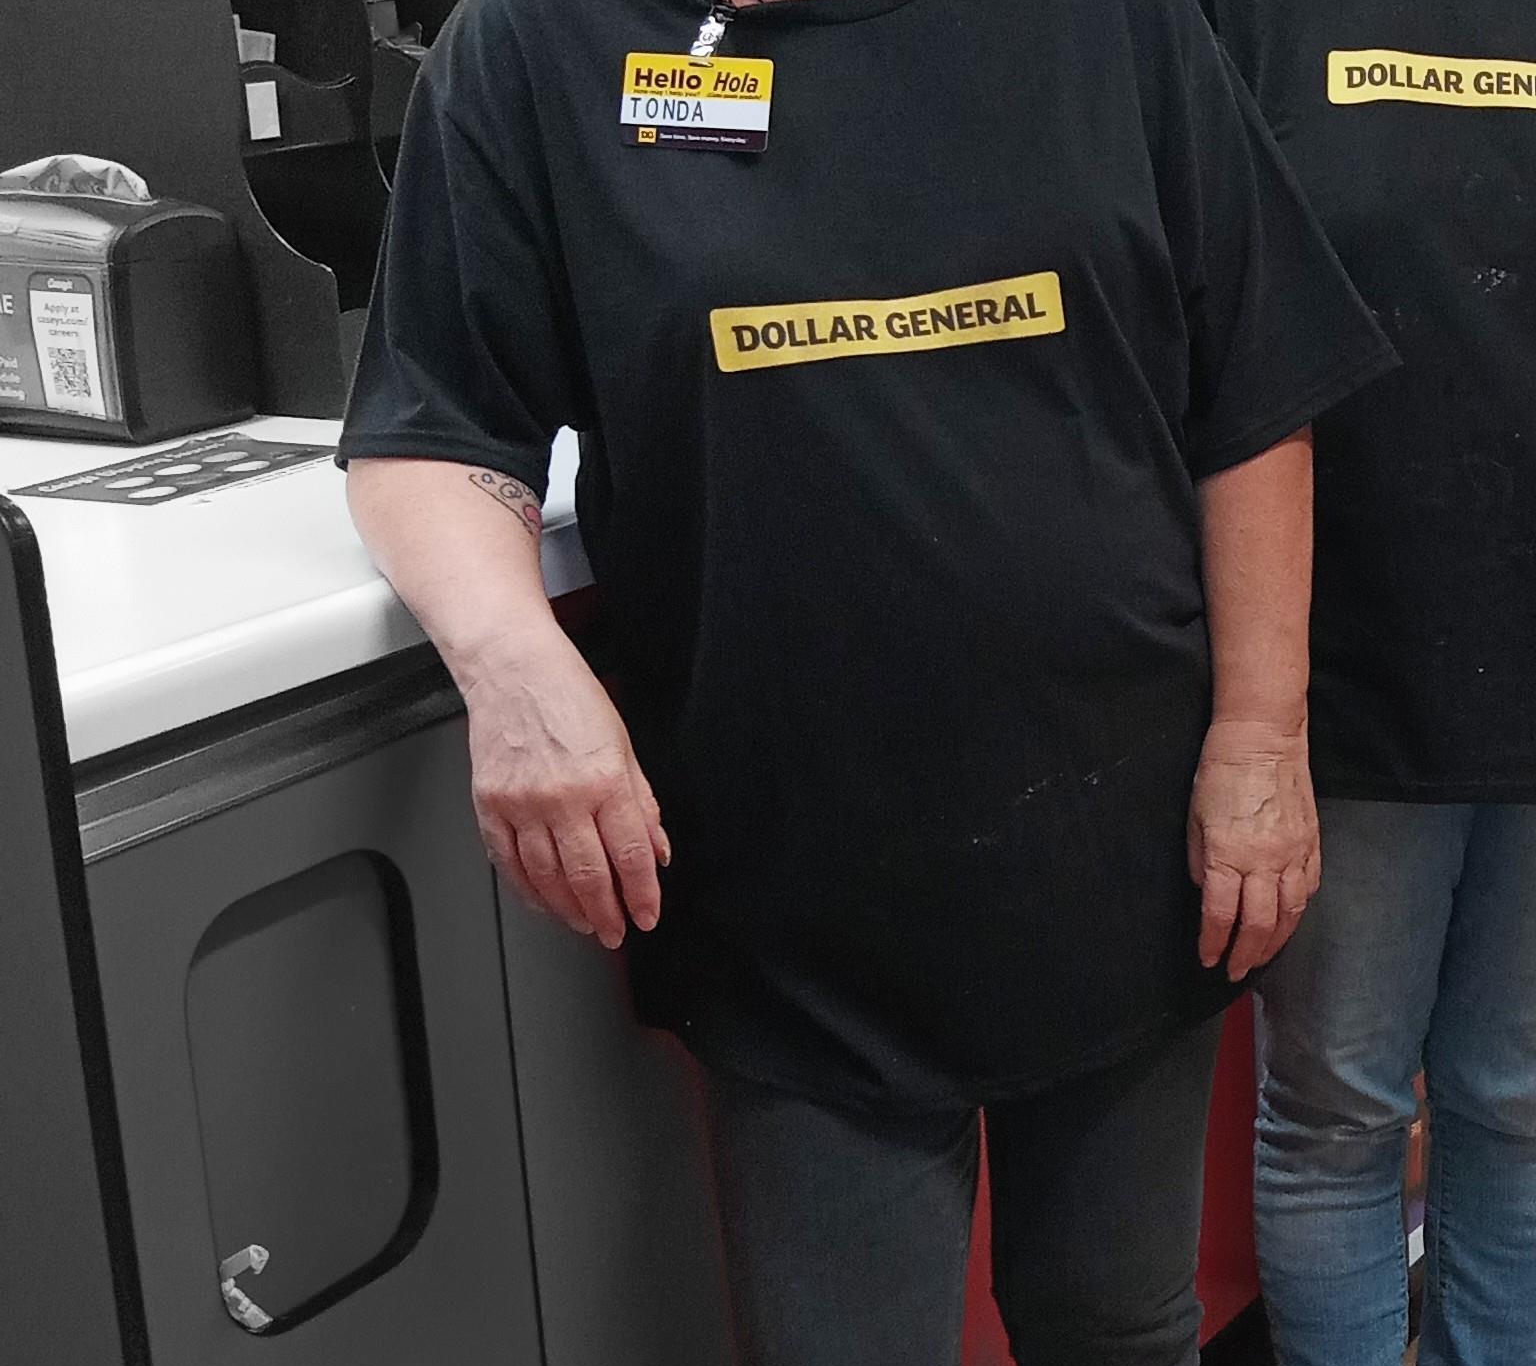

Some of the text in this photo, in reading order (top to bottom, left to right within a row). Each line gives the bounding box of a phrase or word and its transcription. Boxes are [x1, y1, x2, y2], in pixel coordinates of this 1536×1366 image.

[634, 68, 759, 93] Hello Hola
[1345, 63, 1464, 95] DOLLAR
[631, 97, 704, 122] TONDA
[732, 292, 1047, 352] DOLLAR GENERAL
